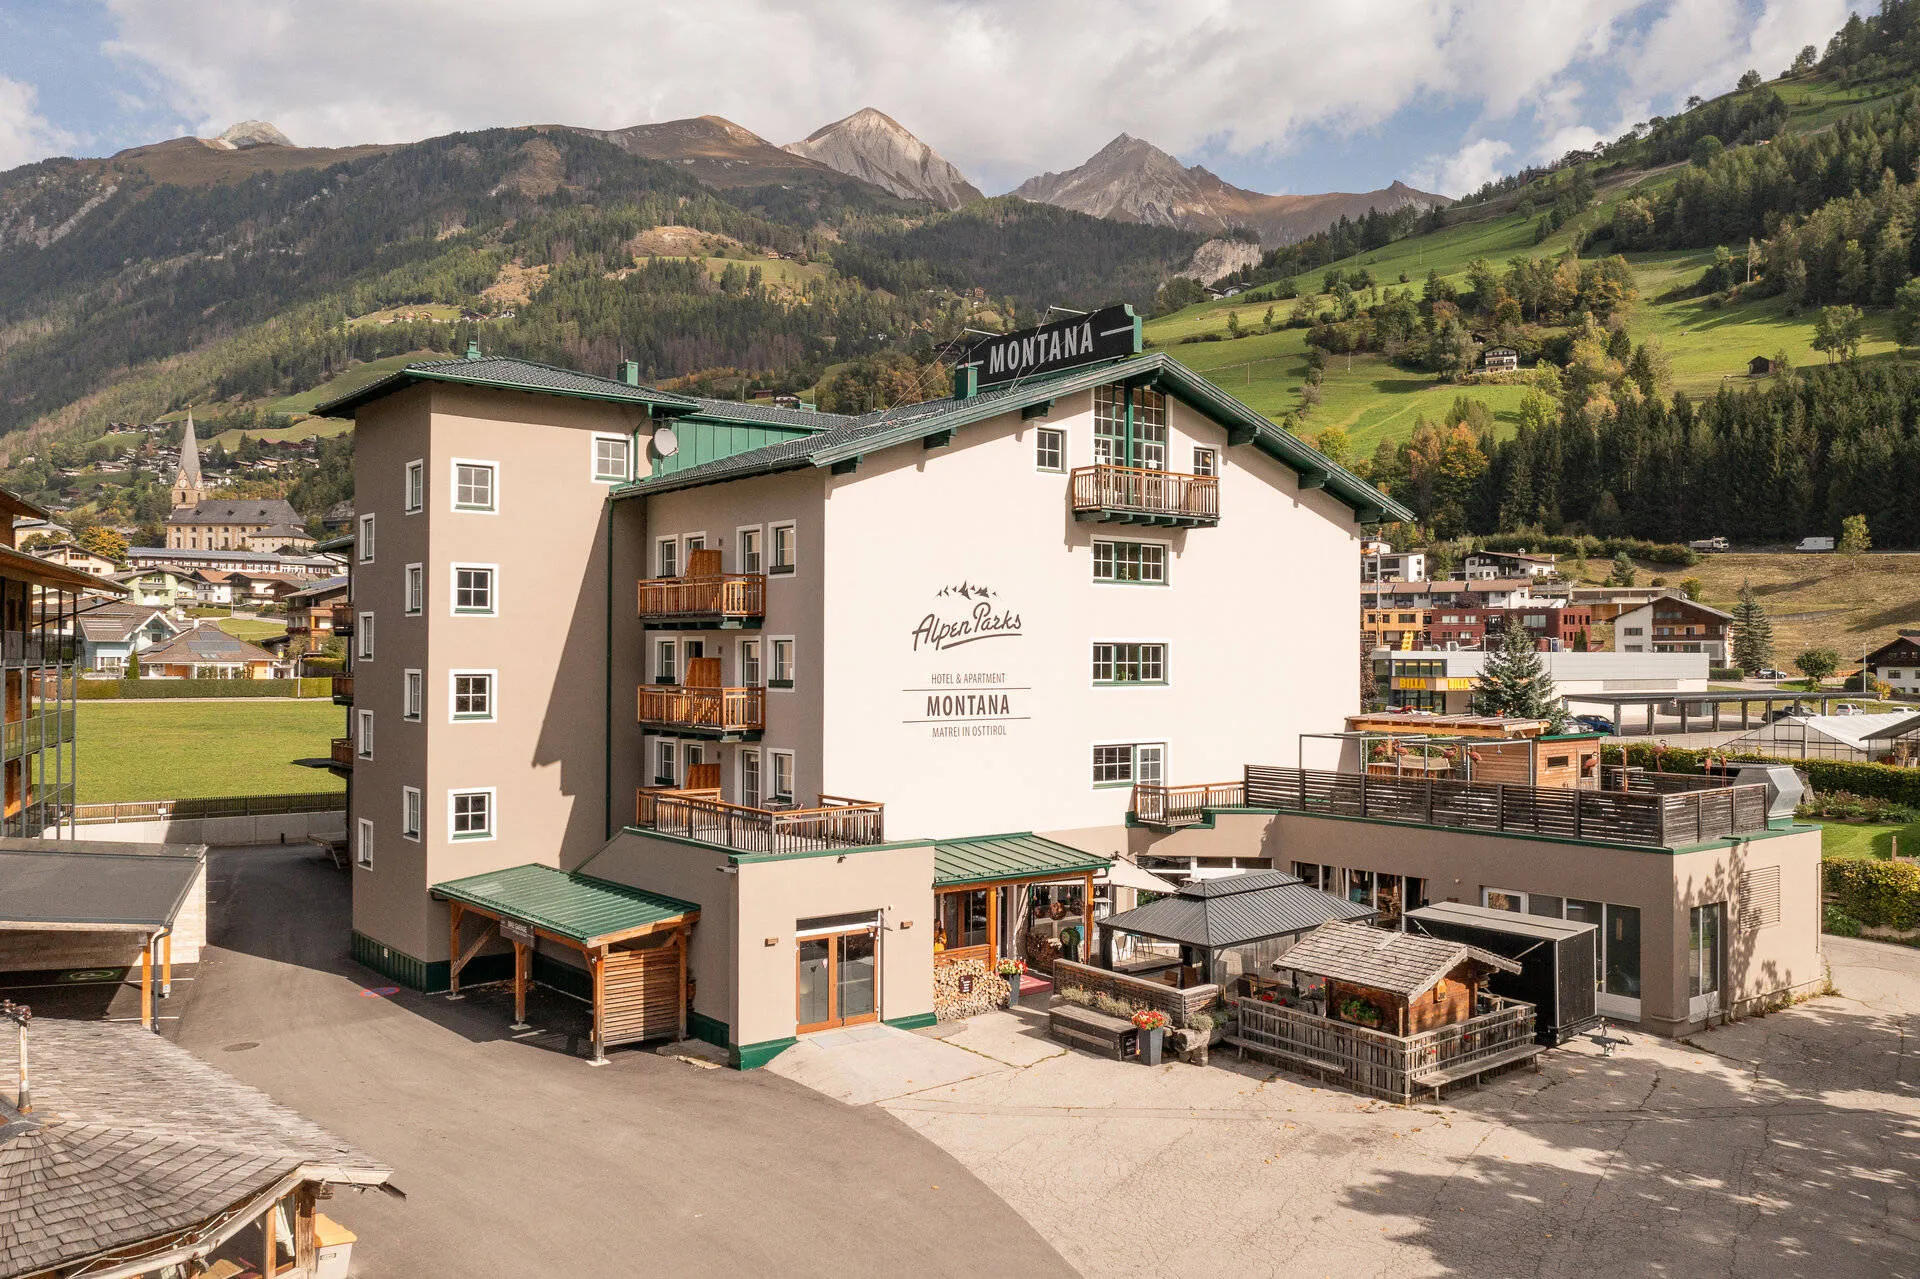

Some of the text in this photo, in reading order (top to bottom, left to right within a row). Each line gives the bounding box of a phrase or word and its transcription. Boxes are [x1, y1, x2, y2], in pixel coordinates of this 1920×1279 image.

[989, 322, 1094, 375] MONTANA
[931, 672, 1006, 685] HOTEL & APARTMENT
[1399, 677, 1427, 690] BILLA
[926, 694, 1010, 717] MONTANA
[932, 724, 1007, 738] MATREI IN OSTTIROL
